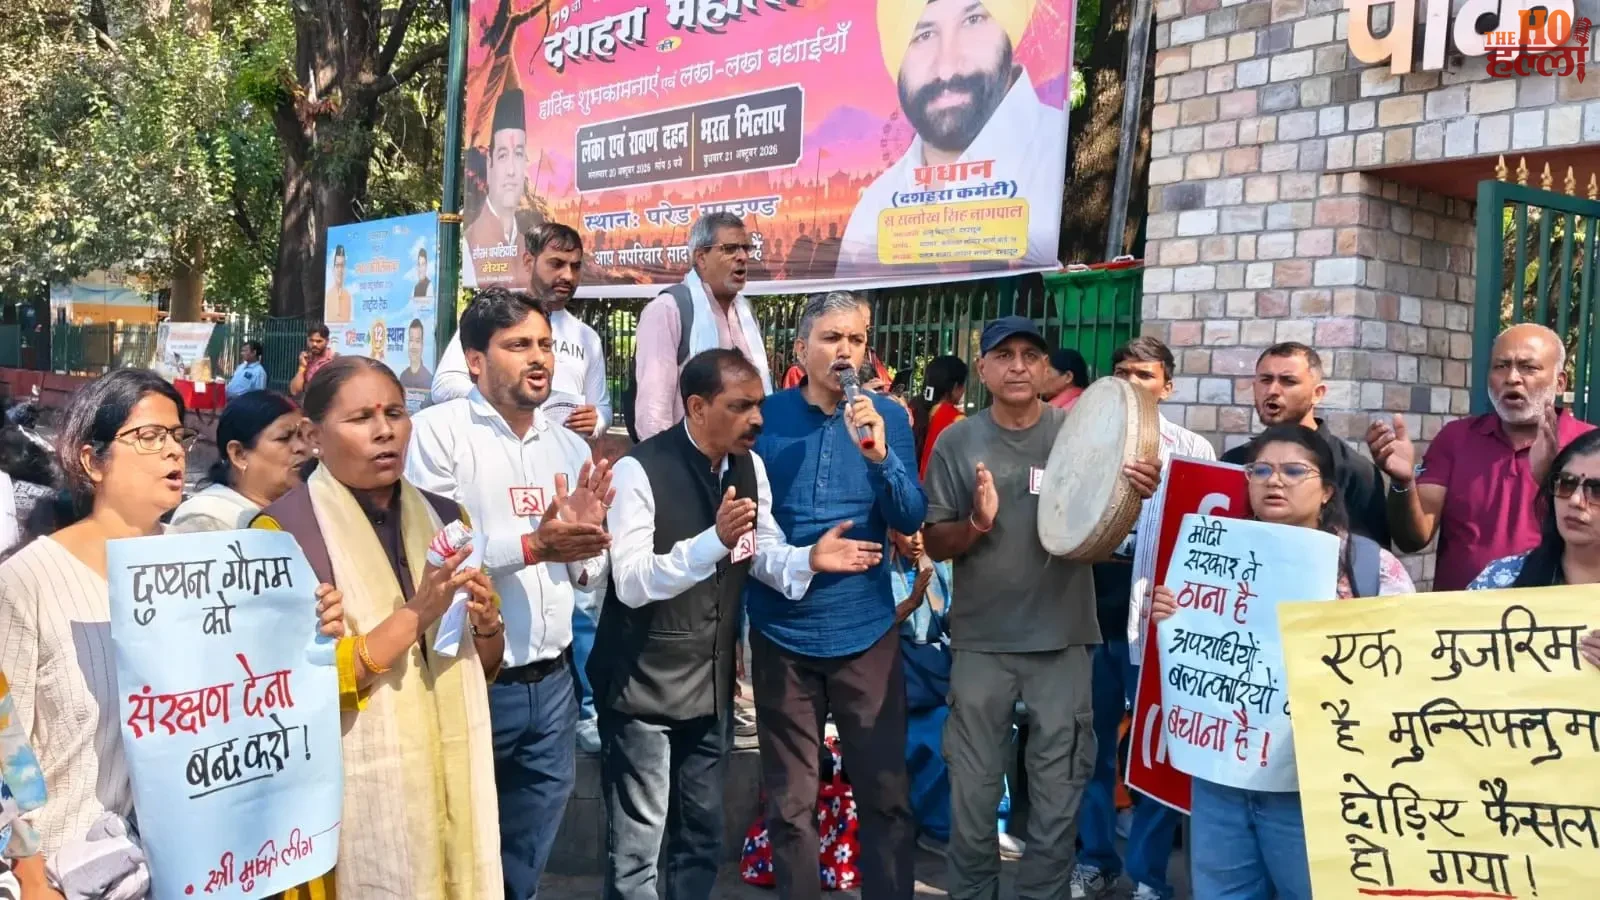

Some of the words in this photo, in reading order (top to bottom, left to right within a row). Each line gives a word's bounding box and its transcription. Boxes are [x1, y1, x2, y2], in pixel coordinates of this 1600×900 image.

[544, 6, 649, 72] दशहरा
[538, 89, 575, 120] हार्दिक
[661, 71, 677, 95] एवं
[580, 131, 607, 164] लंका
[608, 125, 626, 159] एवं
[628, 127, 659, 156] रावण
[662, 121, 689, 150] दहन
[700, 114, 731, 144] भरत
[734, 103, 787, 139] मिलाप
[759, 144, 778, 157] 2026
[913, 159, 996, 187] प्रधान
[645, 201, 695, 227] परेड
[970, 205, 1024, 221] नागपाल
[594, 249, 615, 265] आप
[617, 242, 664, 266] सपरिवार
[666, 246, 690, 264] साद
[1187, 516, 1228, 546] मोदी
[222, 540, 293, 596] गौतम
[1184, 549, 1241, 580] सरकार
[1241, 551, 1263, 582] ने
[202, 590, 237, 635] को
[1176, 580, 1231, 616] ठाना
[1233, 581, 1258, 625] है
[1321, 629, 1402, 685] एक
[1430, 604, 1588, 681] मुजरिम
[127, 685, 235, 739] संरक्षण
[236, 653, 295, 718] देना
[1168, 704, 1232, 752] बचाना
[1321, 699, 1364, 755] है
[1479, 777, 1600, 849] फैसल
[281, 827, 313, 866] लीग
[1345, 833, 1396, 887] हो
